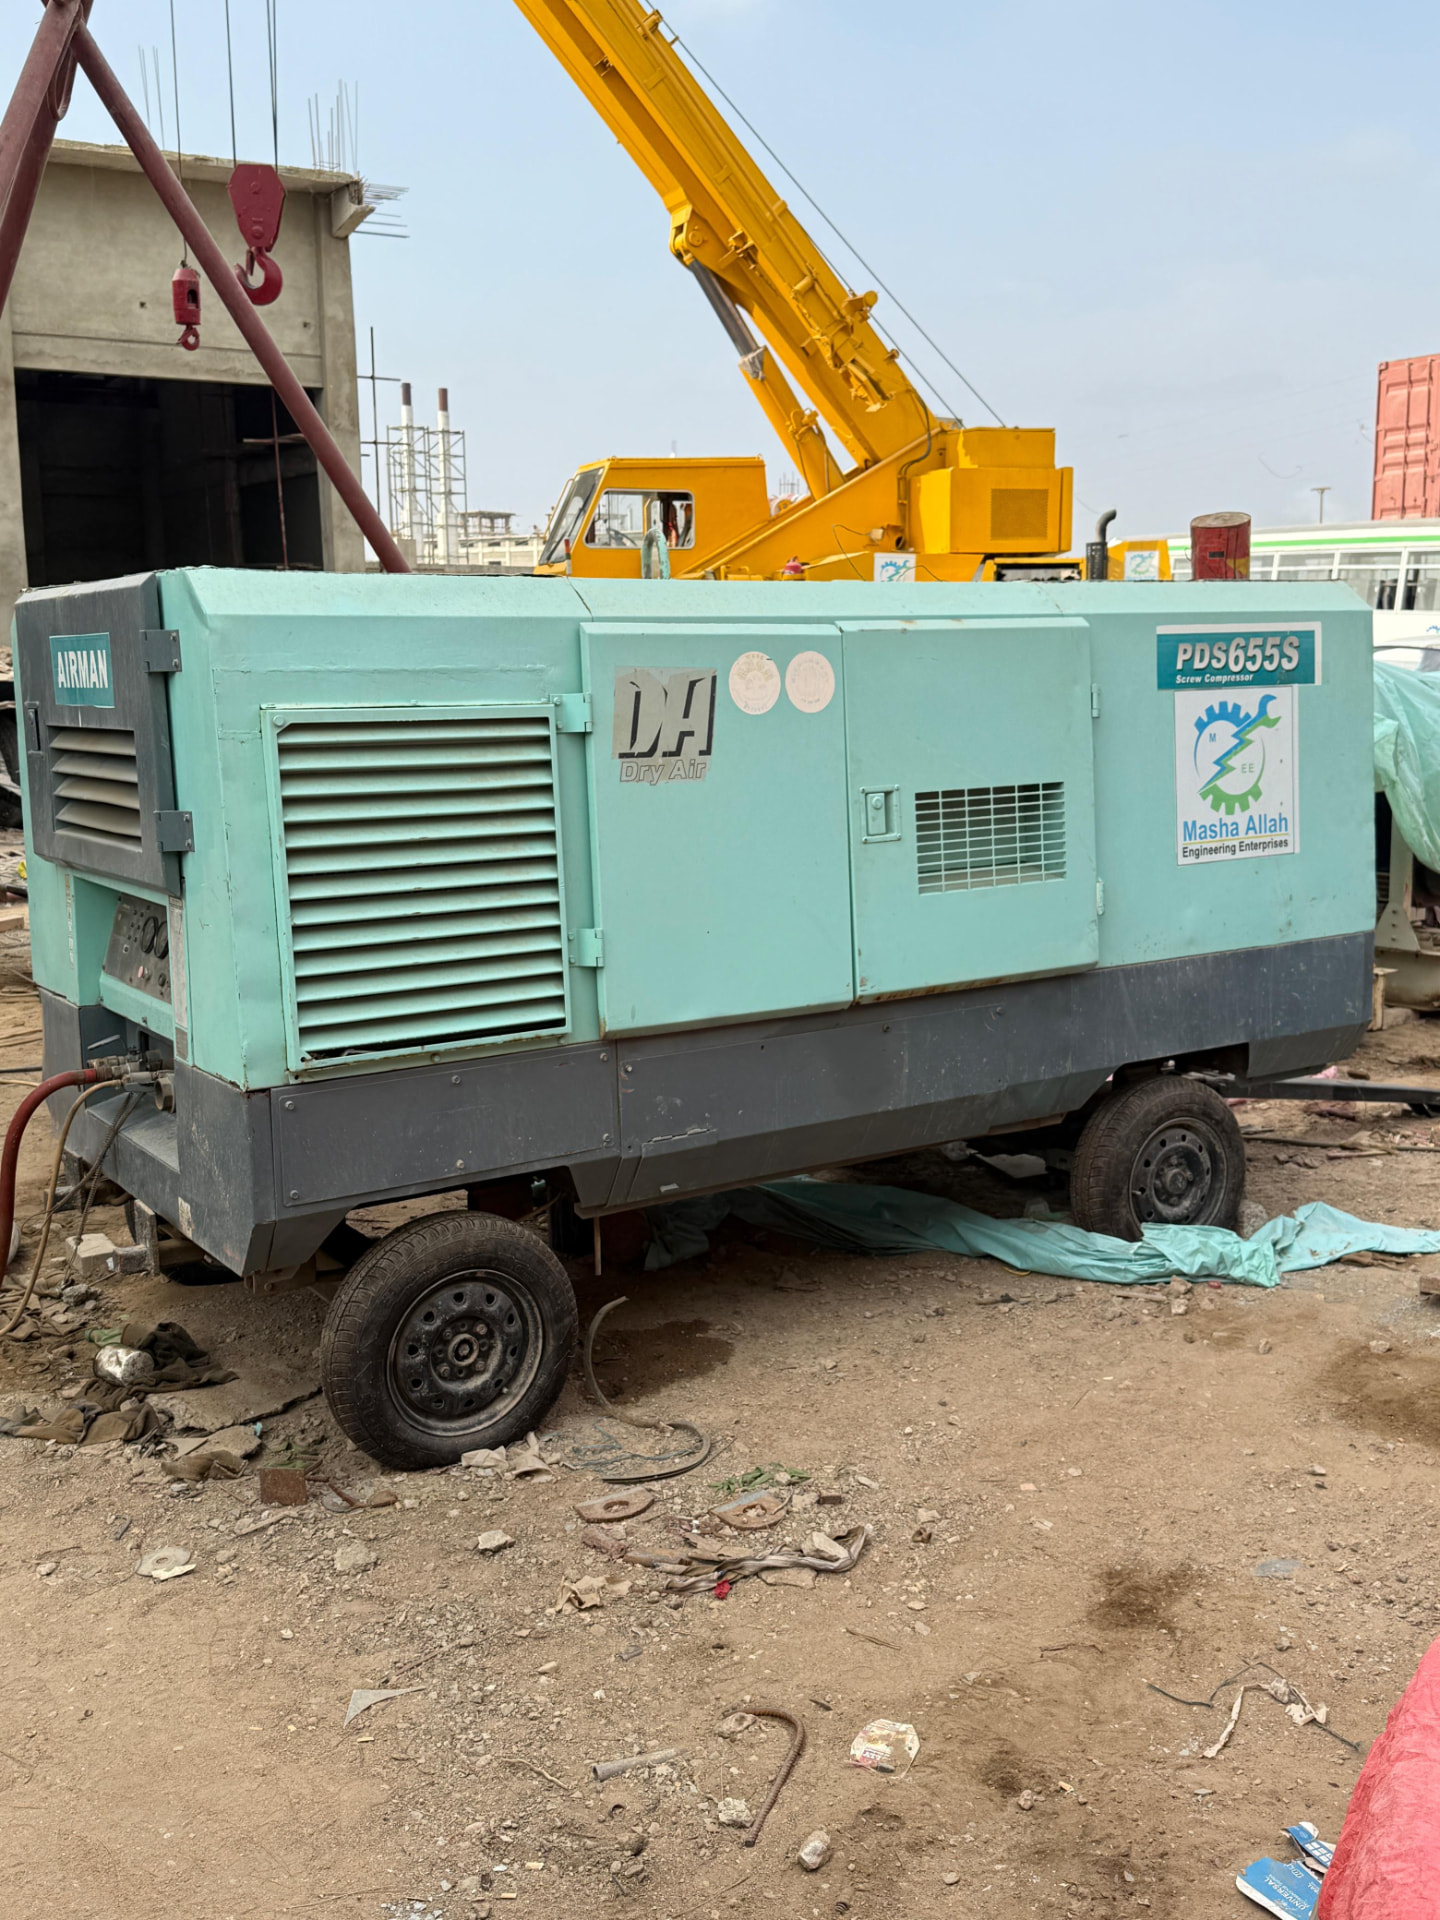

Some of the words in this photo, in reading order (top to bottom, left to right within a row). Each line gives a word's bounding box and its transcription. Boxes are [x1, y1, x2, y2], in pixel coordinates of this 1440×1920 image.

[1176, 635, 1300, 673] PDS655S
[57, 649, 109, 689] AIRMAN
[1176, 674, 1202, 684] Screw
[1204, 673, 1254, 683] Compressor
[1208, 733, 1217, 742] M
[620, 761, 665, 786] Dry
[668, 759, 706, 780] Air
[1183, 820, 1239, 842] Masha
[1245, 813, 1289, 835] Allah
[1182, 842, 1237, 858] Engineering
[1239, 838, 1289, 854] Enterprises
[1264, 1875, 1306, 1910] UNIVERSAL
